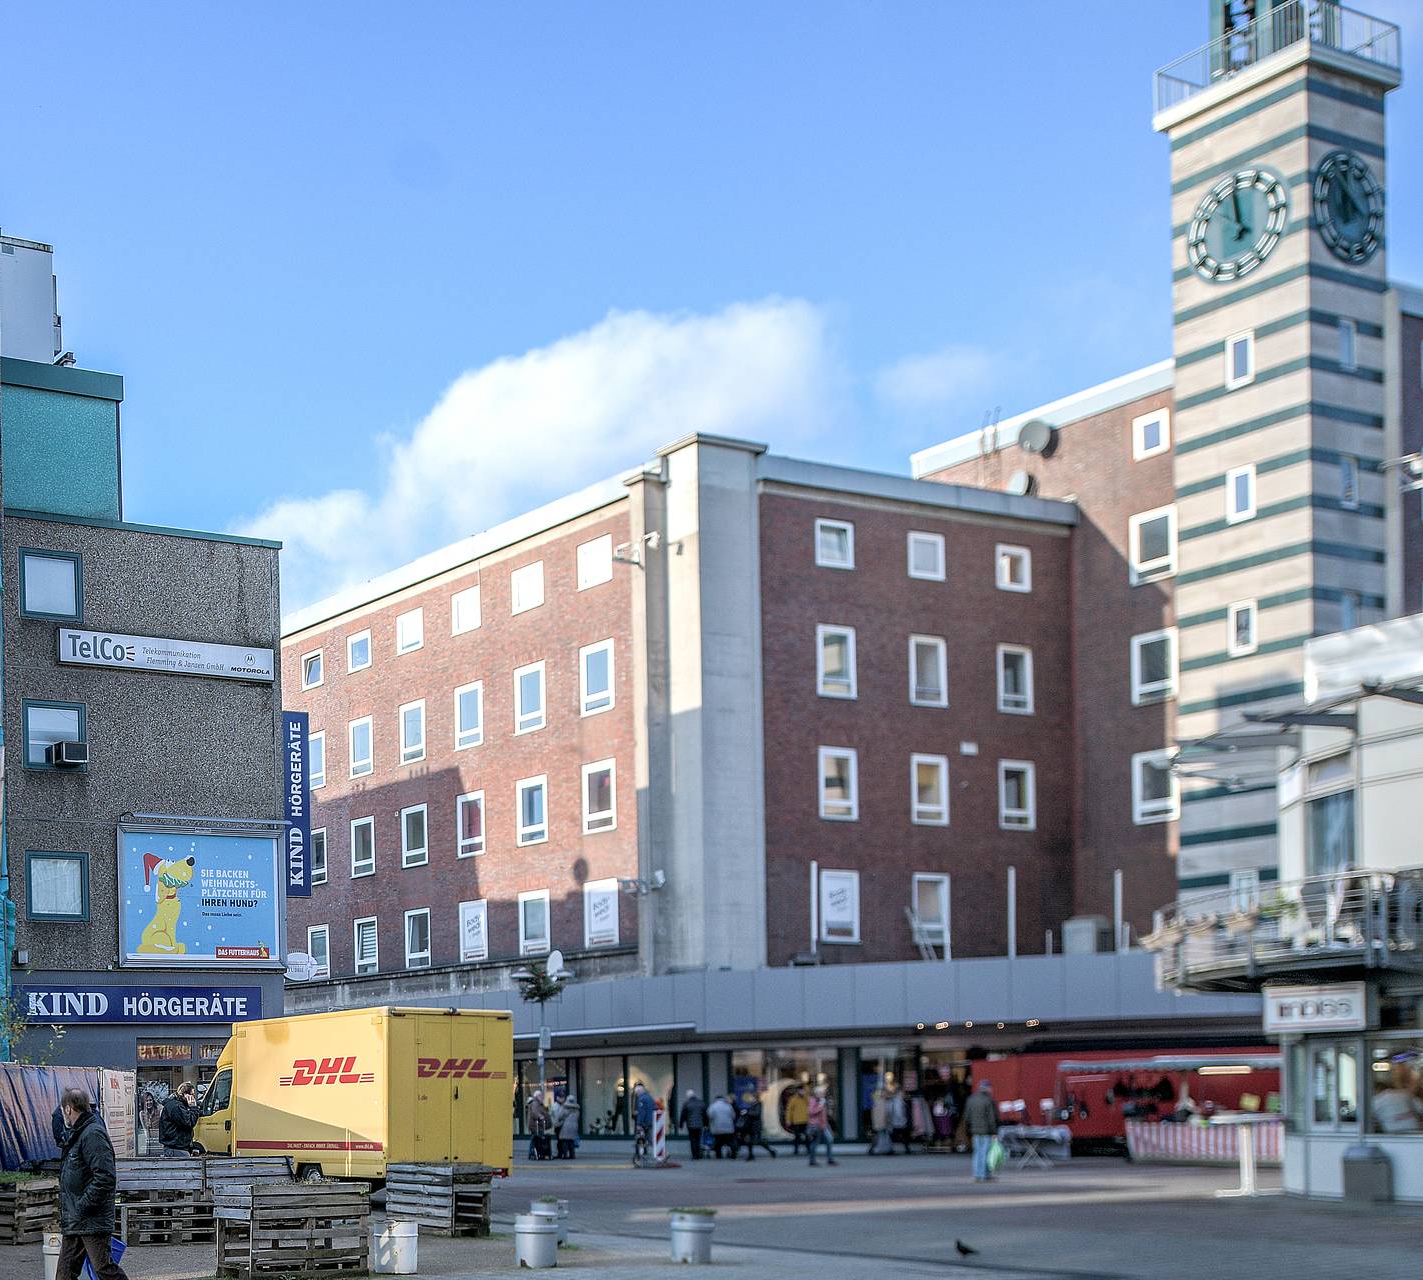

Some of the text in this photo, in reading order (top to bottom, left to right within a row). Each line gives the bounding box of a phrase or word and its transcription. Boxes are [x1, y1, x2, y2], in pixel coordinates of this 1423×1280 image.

[67, 634, 126, 662] TelCo
[142, 647, 201, 659] Telekommunikation
[147, 657, 176, 668] Flemming
[206, 662, 225, 671] GmbH
[230, 666, 270, 675] MOTOROLA
[287, 721, 304, 887] KIND HÖRGERÄTE
[200, 869, 249, 878] SIE BACKEN
[201, 879, 258, 888] WEIHNACHTS-
[201, 888, 267, 898] PLÄTZCHEN FÜR
[201, 898, 258, 907] IHREN HUND?
[27, 992, 248, 1016] KIND HÖRGERÄTE
[291, 1056, 361, 1086] DHL
[417, 1058, 491, 1079] DHL
